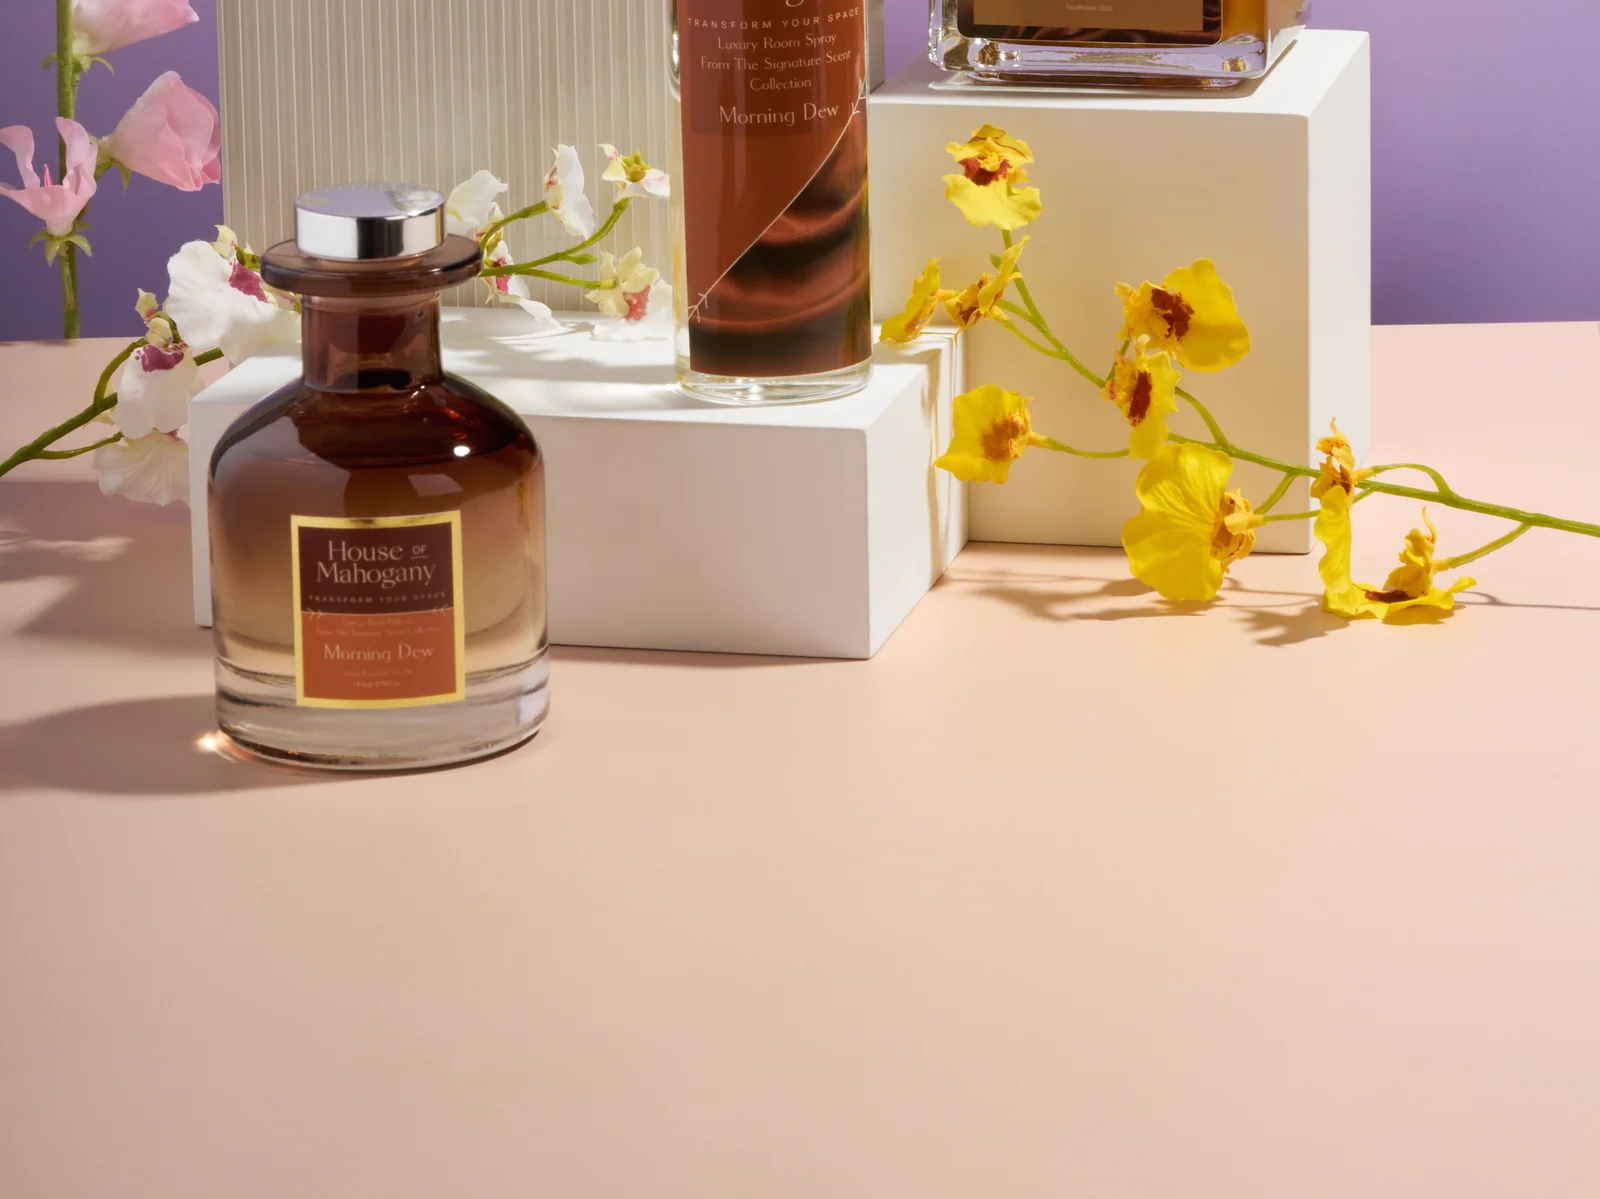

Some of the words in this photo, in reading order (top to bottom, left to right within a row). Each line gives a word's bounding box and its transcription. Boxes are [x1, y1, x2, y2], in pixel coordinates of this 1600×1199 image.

[687, 17, 773, 30] TRANSFORM
[782, 16, 820, 28] YOUR
[827, 7, 859, 23] SPACE
[717, 37, 759, 52] Luxury
[763, 37, 801, 49] Room
[805, 33, 837, 47] Spray
[700, 56, 730, 70] From
[734, 57, 759, 70] The
[764, 57, 822, 72] Signature
[825, 50, 852, 64] Scent
[749, 78, 812, 92] Collection
[719, 105, 795, 127] Morning
[803, 103, 839, 121] Dew
[328, 540, 403, 562] House
[412, 545, 427, 555] OF
[316, 561, 436, 589] Mahogany
[324, 644, 391, 663] Morning
[398, 643, 435, 659] Dew
